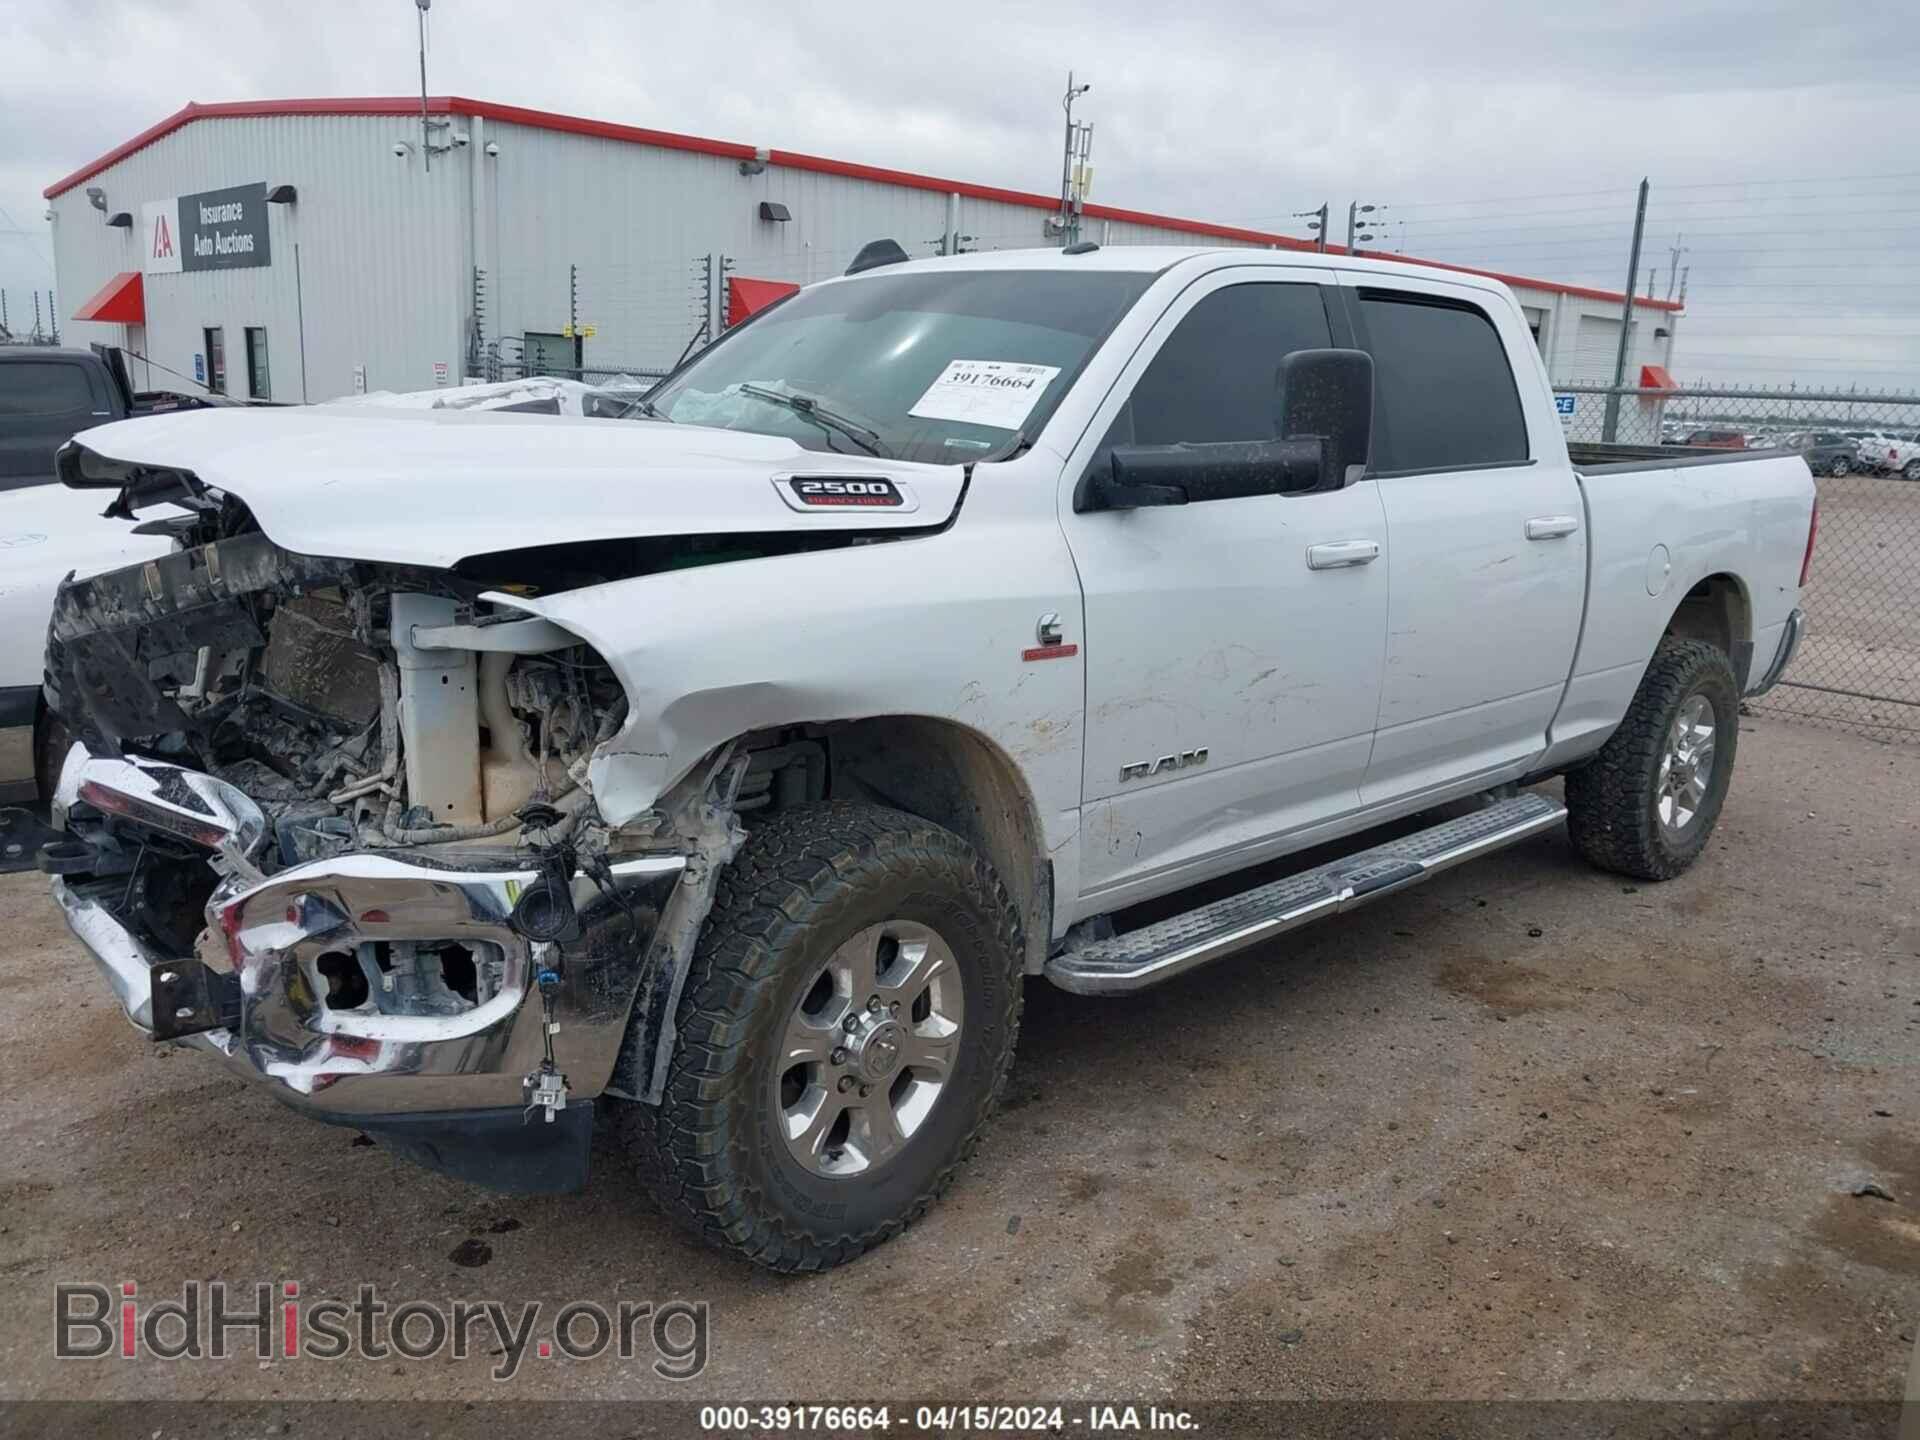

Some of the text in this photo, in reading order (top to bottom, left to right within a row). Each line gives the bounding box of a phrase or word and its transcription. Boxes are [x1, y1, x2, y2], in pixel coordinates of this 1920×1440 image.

[199, 201, 243, 225] Insurance
[193, 229, 254, 257] Auto Auctions
[950, 372, 1036, 390] 39176664
[800, 482, 889, 494] 2500
[1119, 747, 1209, 783] RAM
